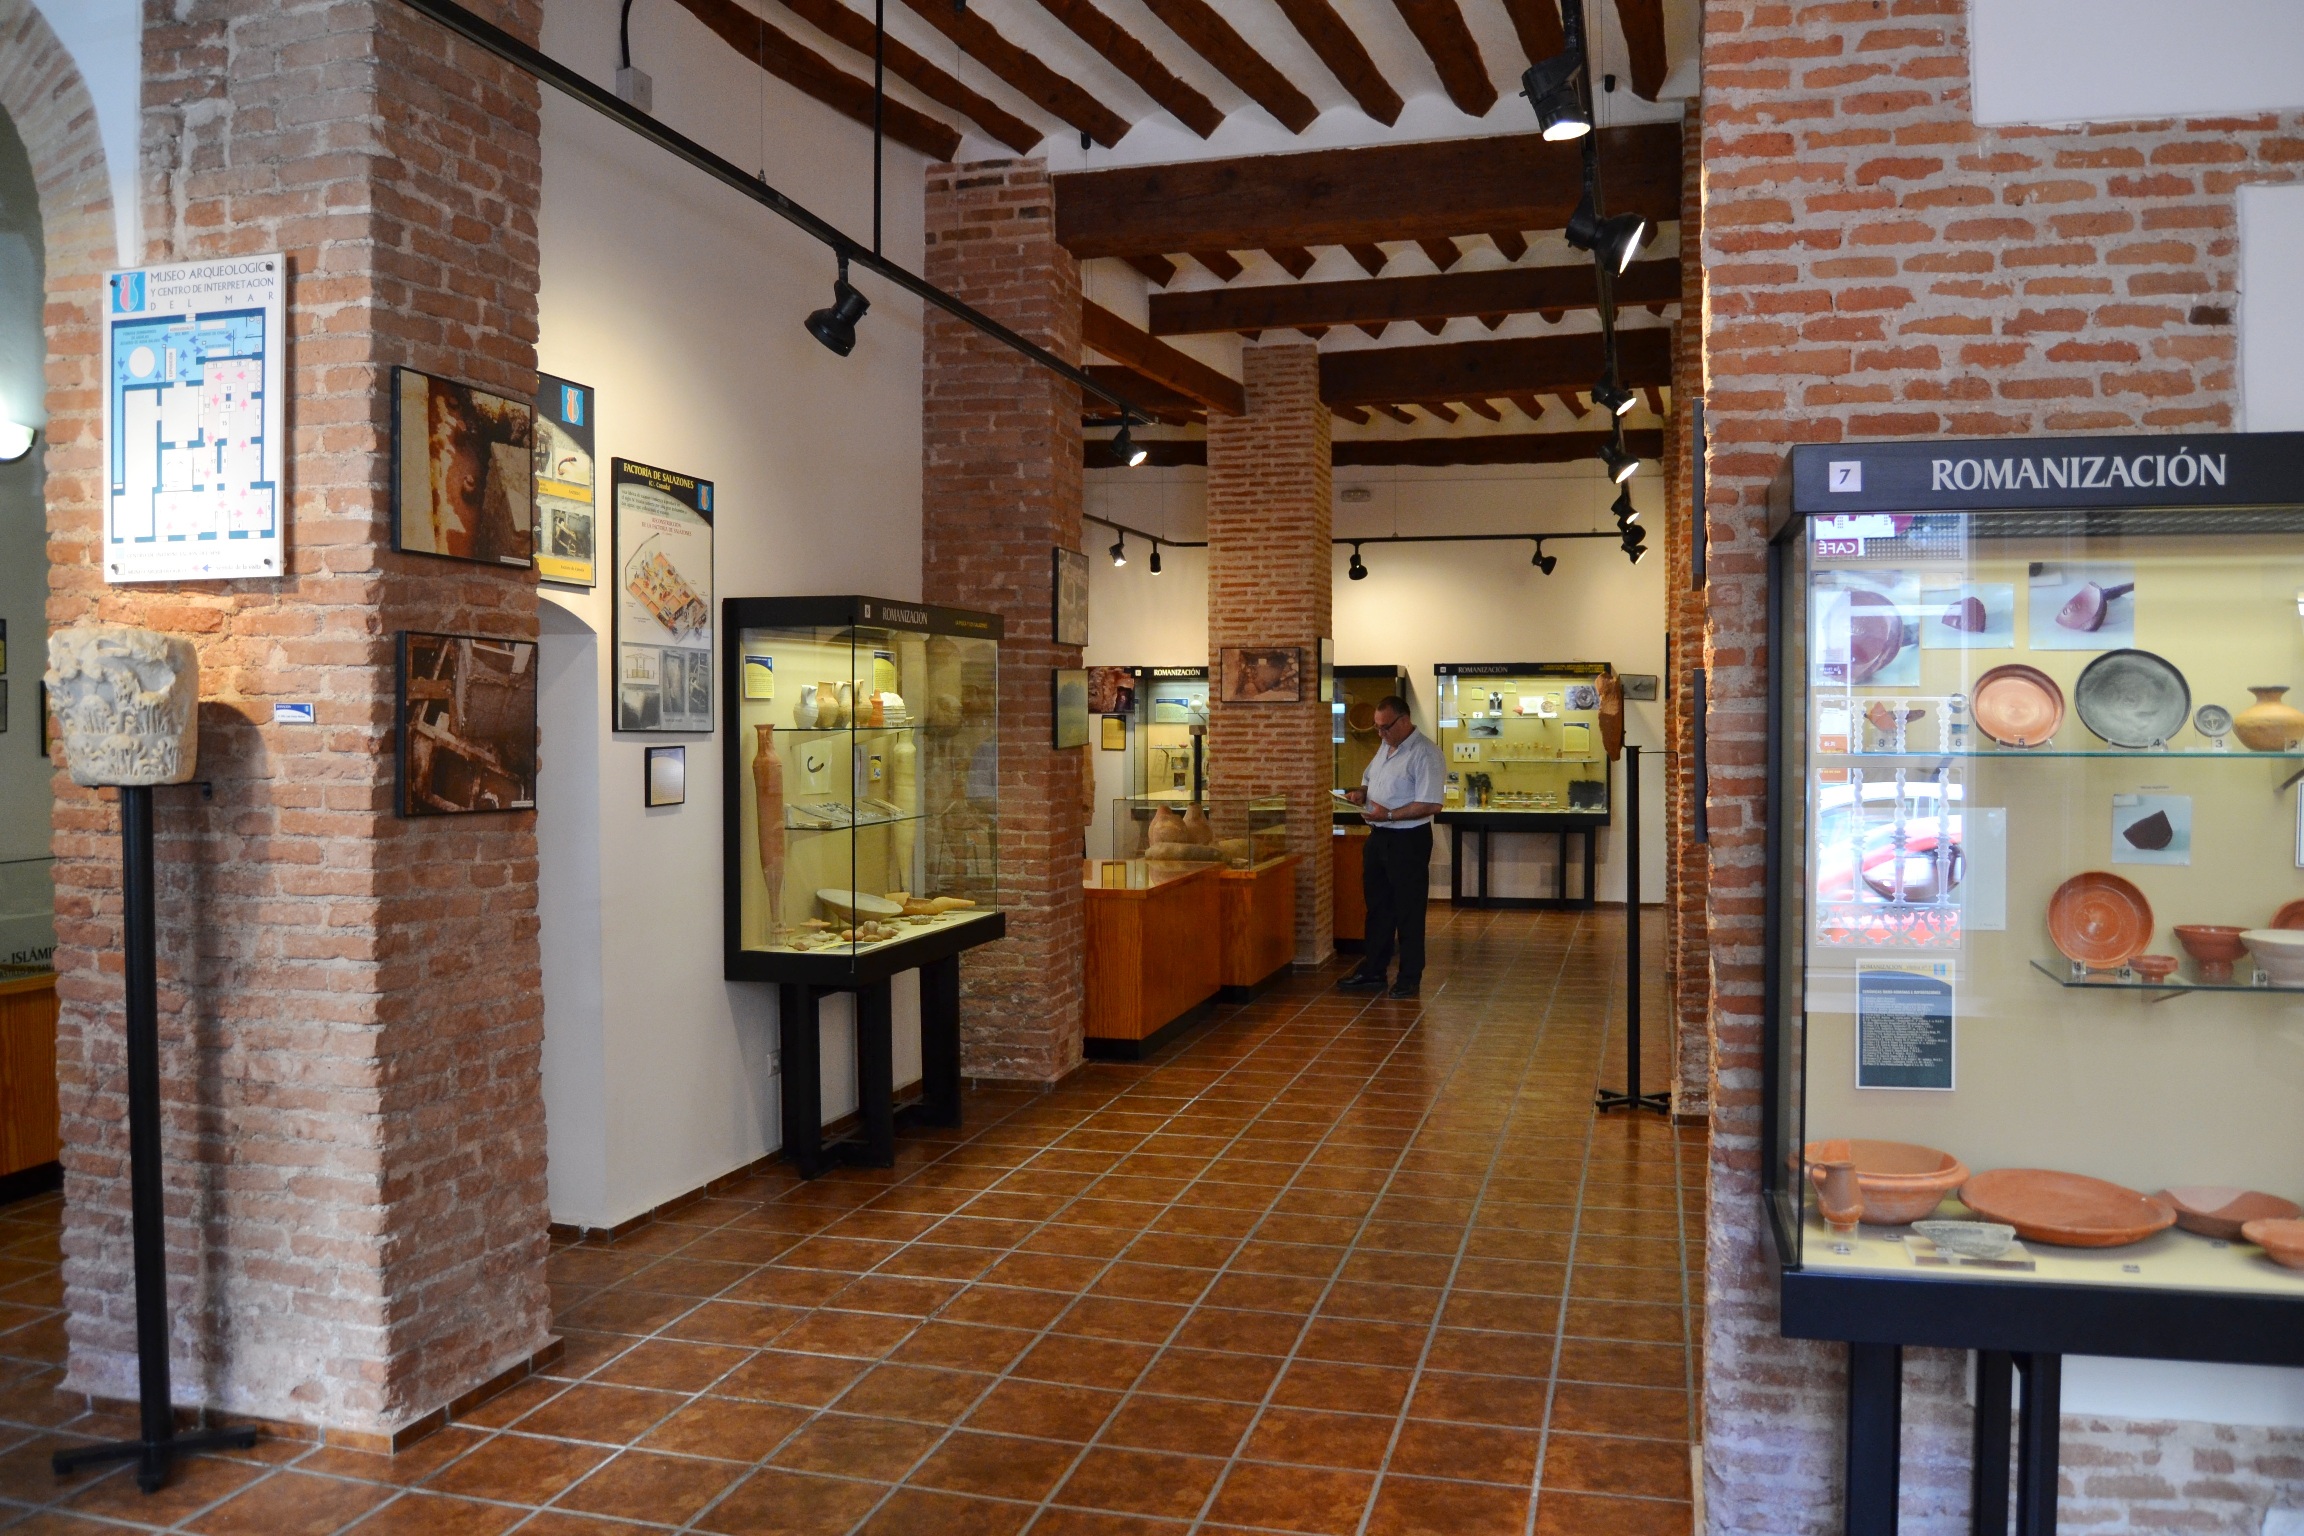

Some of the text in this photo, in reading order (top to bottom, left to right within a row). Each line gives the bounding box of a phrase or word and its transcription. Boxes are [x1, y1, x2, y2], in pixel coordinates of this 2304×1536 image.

[151, 269, 186, 283] MUSEO
[151, 277, 274, 297] Y CENTRO DE INTERPRETACION
[1839, 446, 2227, 491] 7 ROMANIZACIÓN
[623, 462, 694, 489] FACTORÍA DE SALAZONES
[882, 607, 928, 625] ROMANIZACIÓN
[1153, 668, 1201, 676] ROMANIZACIÓN
[1878, 739, 1885, 748] 8
[1955, 738, 1962, 747] 6
[2018, 738, 2025, 747] 5
[2153, 738, 2160, 747] 4
[2215, 739, 2223, 748] 3
[2290, 740, 2298, 749] 2
[11, 946, 57, 965] ISLÁMI
[2118, 969, 2130, 978] 14
[2256, 973, 2266, 983] 13
